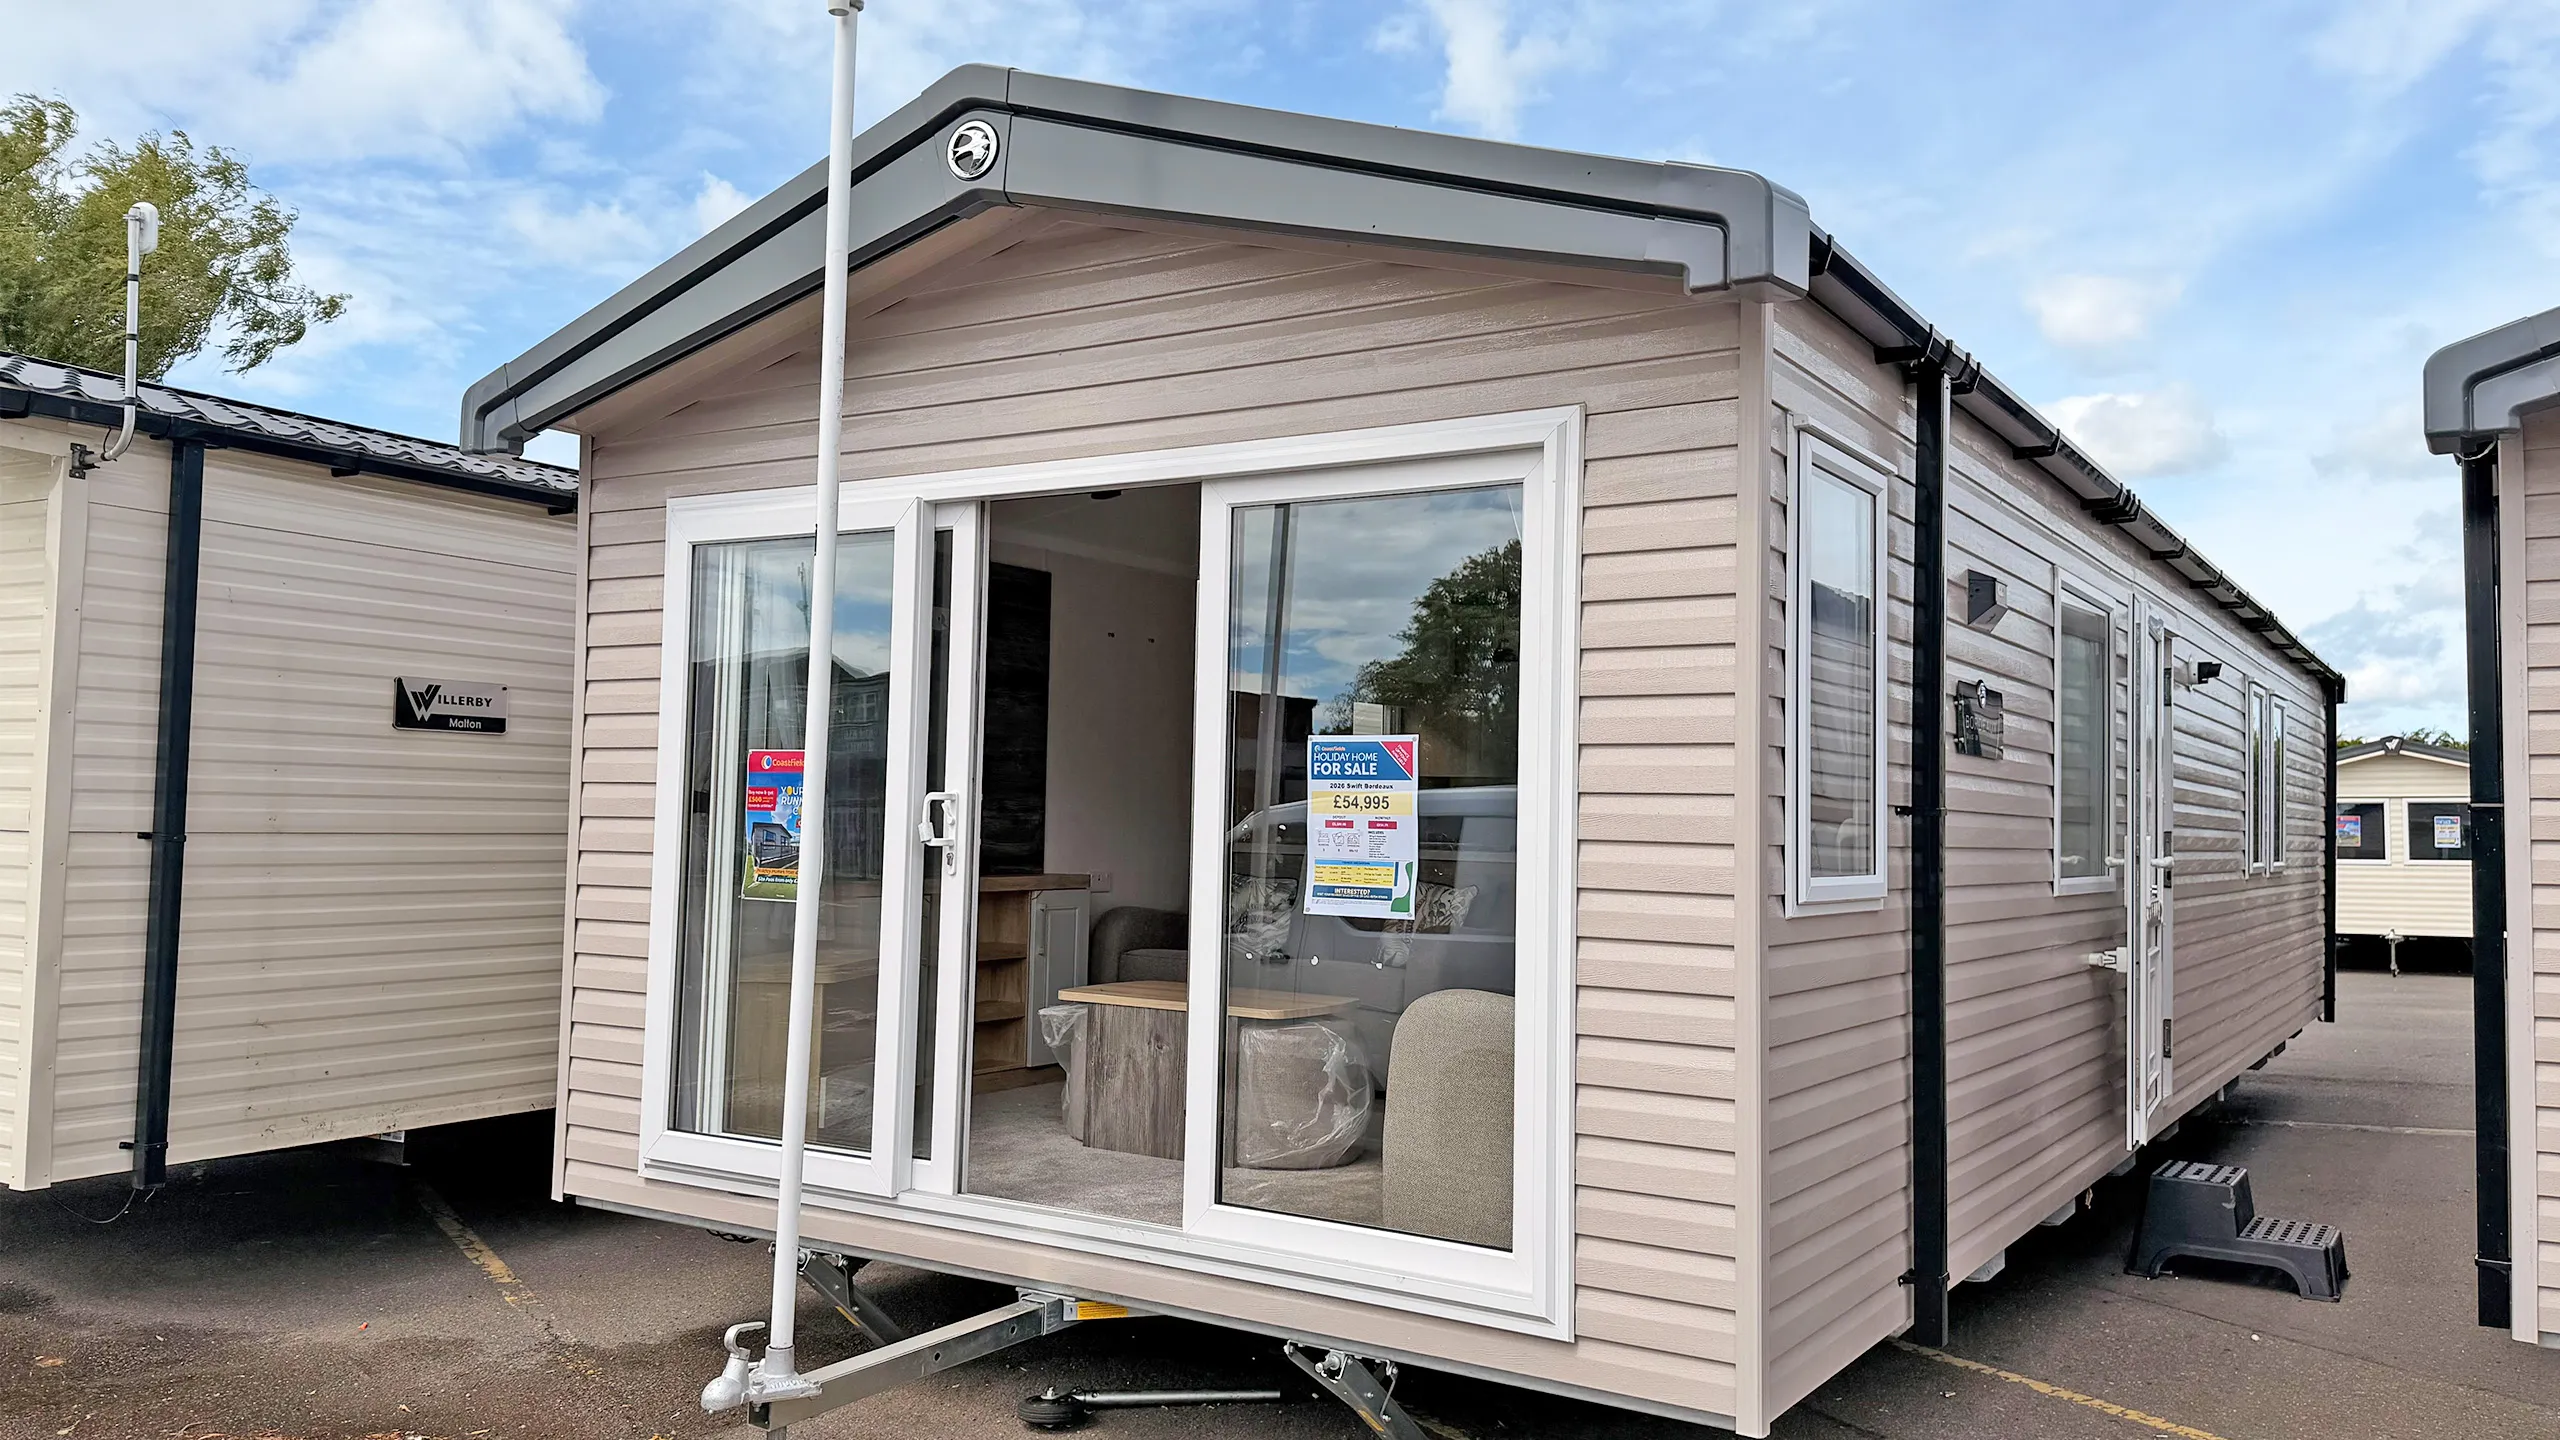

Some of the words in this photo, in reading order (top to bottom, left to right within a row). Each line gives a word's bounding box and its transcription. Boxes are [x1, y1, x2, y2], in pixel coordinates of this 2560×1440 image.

[448, 717, 482, 729] Malton
[1313, 752, 1350, 761] HOLIDAY
[1351, 752, 1378, 761] HOME
[1313, 762, 1341, 776] FOR
[1344, 762, 1378, 776] SALE
[1333, 795, 1389, 812] £54,995
[1334, 888, 1371, 896] INTERESTED?
